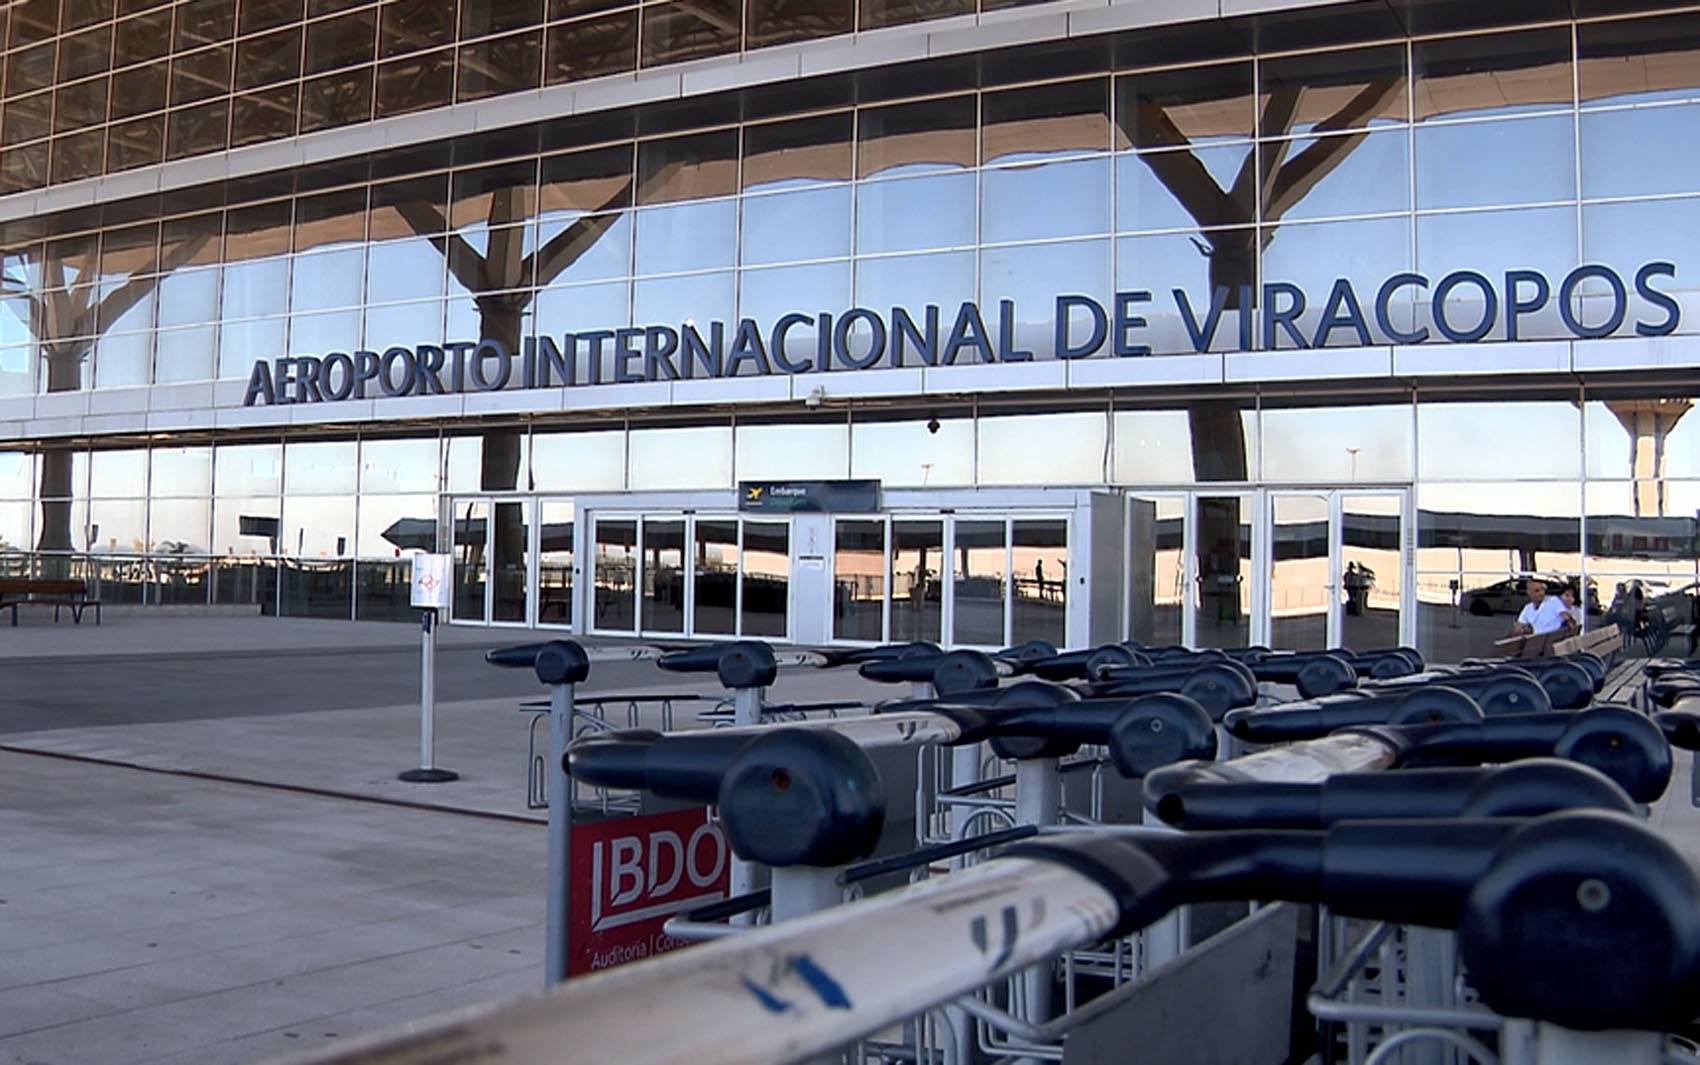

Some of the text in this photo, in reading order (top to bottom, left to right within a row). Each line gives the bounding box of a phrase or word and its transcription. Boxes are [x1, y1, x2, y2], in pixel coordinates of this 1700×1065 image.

[243, 262, 1680, 406] AEROPORTO INTERNACIONAL DE VIRACOPOS
